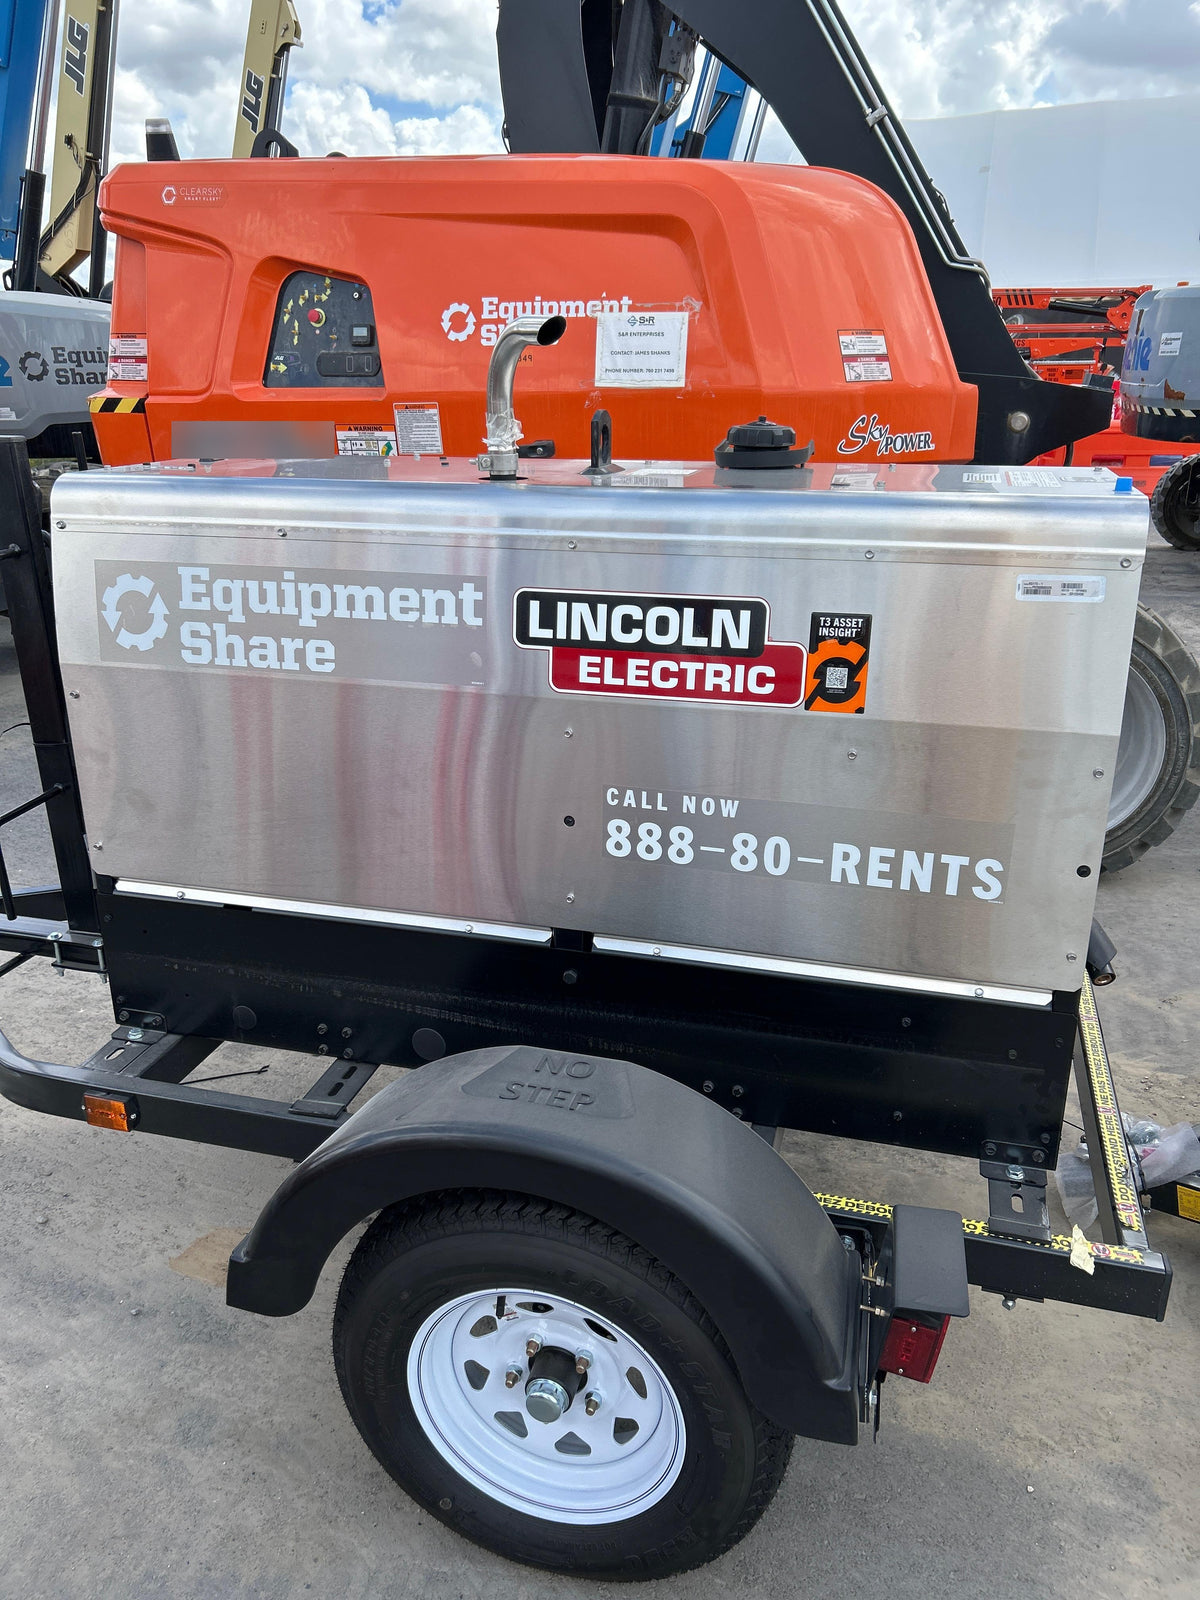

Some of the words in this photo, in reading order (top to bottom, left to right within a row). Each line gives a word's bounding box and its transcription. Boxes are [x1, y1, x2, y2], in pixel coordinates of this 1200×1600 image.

[64, 15, 89, 96] JLG
[241, 68, 264, 134] JLG
[180, 187, 224, 196] CLEARSKY
[54, 368, 107, 386] Shar
[177, 566, 483, 628] Equipment
[528, 599, 752, 650] LINCOLN
[819, 617, 831, 627] T3
[833, 618, 863, 628] ASSET
[179, 620, 336, 673] Share
[578, 655, 776, 696] ELECTRIC
[606, 787, 668, 812] CALL
[682, 794, 740, 819] NOW
[535, 1055, 596, 1079] NO
[499, 1082, 594, 1111] STEP
[1100, 1094, 1109, 1106] NE
[1104, 1114, 1116, 1137] HERE
[1109, 1137, 1122, 1166] STAND
[1115, 1165, 1127, 1185] NOT
[1119, 1186, 1131, 1202] DO
